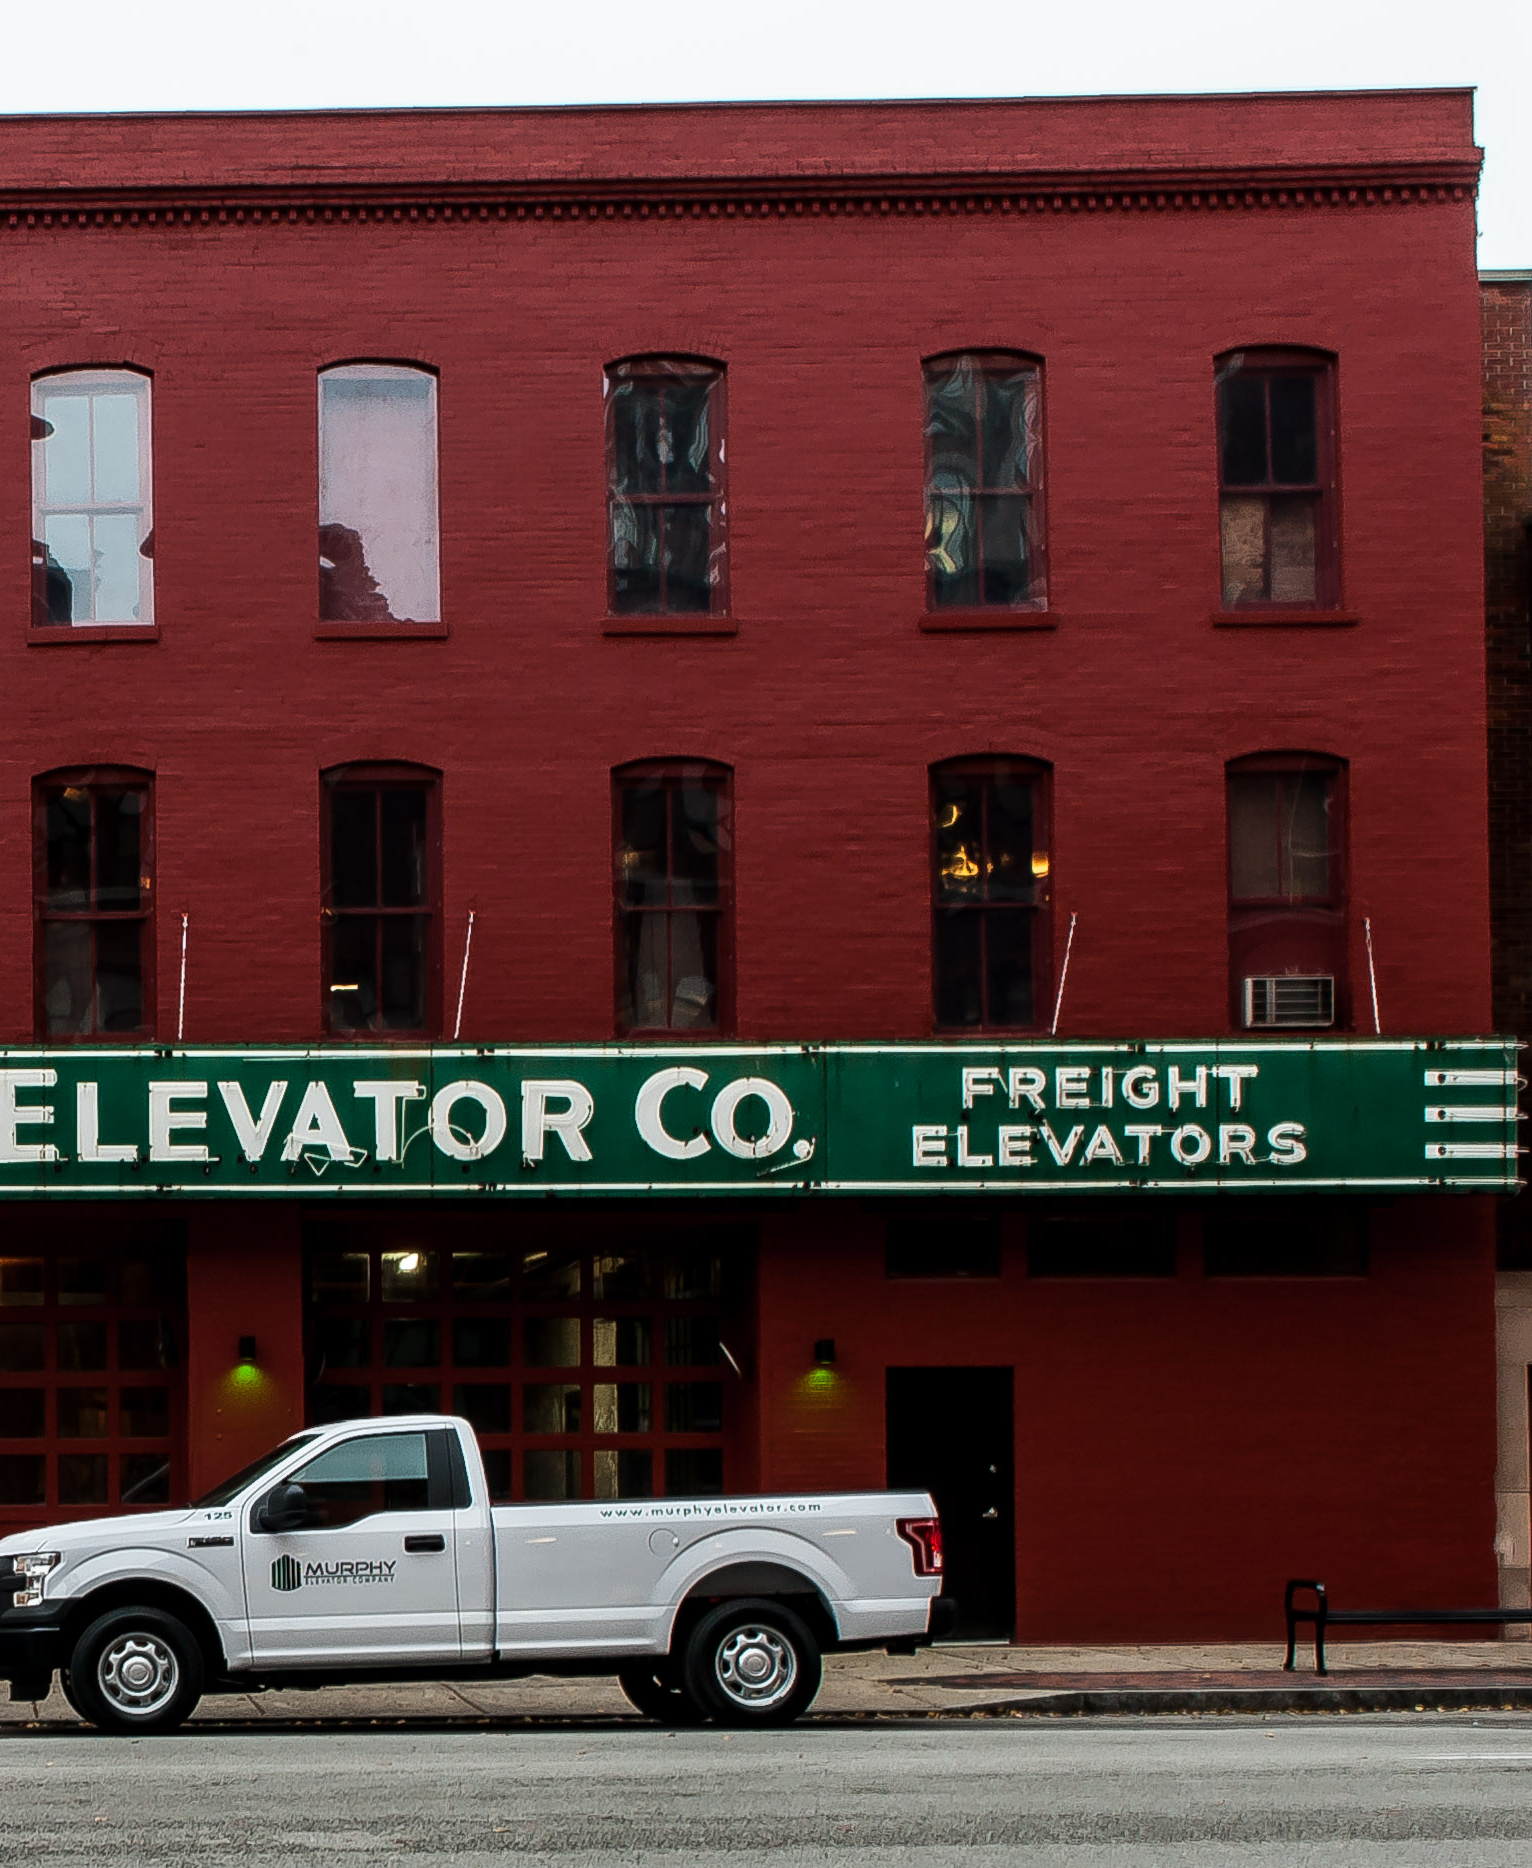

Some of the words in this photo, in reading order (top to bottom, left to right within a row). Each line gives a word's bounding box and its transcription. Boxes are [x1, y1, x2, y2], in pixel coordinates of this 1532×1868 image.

[962, 1065, 1259, 1109] FREIGHT
[635, 1067, 812, 1162] CO.
[912, 1122, 1307, 1167] ELEVATORS
[204, 1511, 233, 1521] 125
[600, 1502, 822, 1518] www.murphyelevator.com
[305, 1560, 397, 1576] MURPHY
[305, 1576, 348, 1586] ELEVATOR
[352, 1575, 395, 1585] COMPANY
